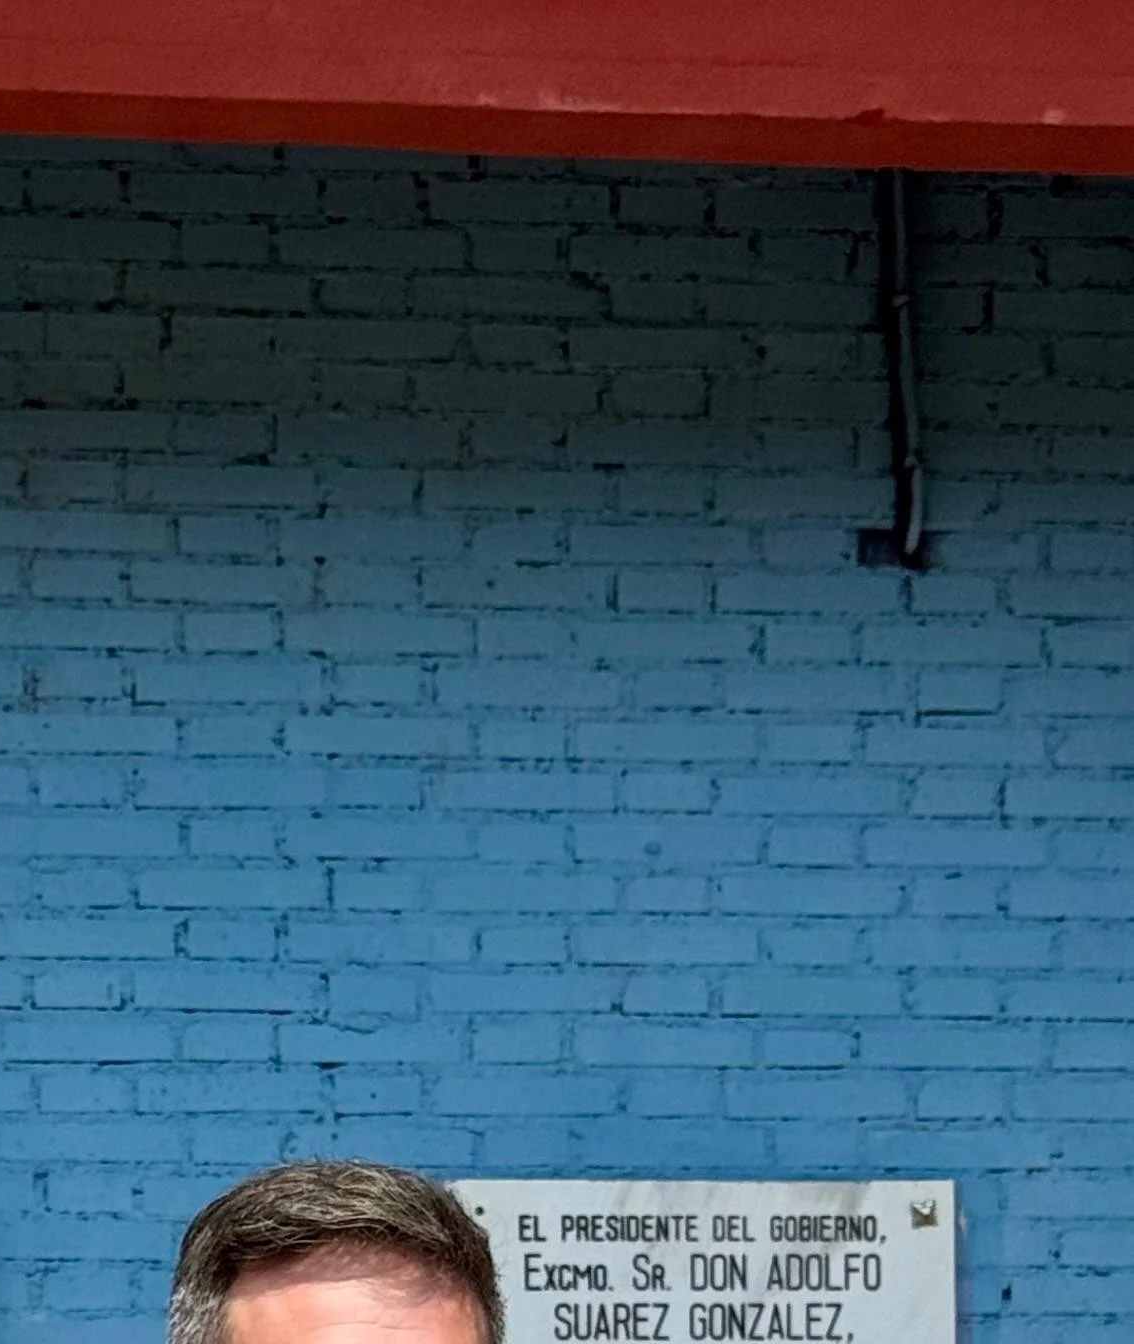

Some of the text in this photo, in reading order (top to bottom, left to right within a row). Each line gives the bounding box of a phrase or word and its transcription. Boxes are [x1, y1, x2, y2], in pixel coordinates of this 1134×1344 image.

[518, 1214, 887, 1245] EL PRESIDENTE DEL GOBIERNO,
[689, 1253, 748, 1292] DON
[766, 1252, 882, 1292] ADOLFO
[553, 1302, 854, 1344] SUAREZ GONZALEZ,
